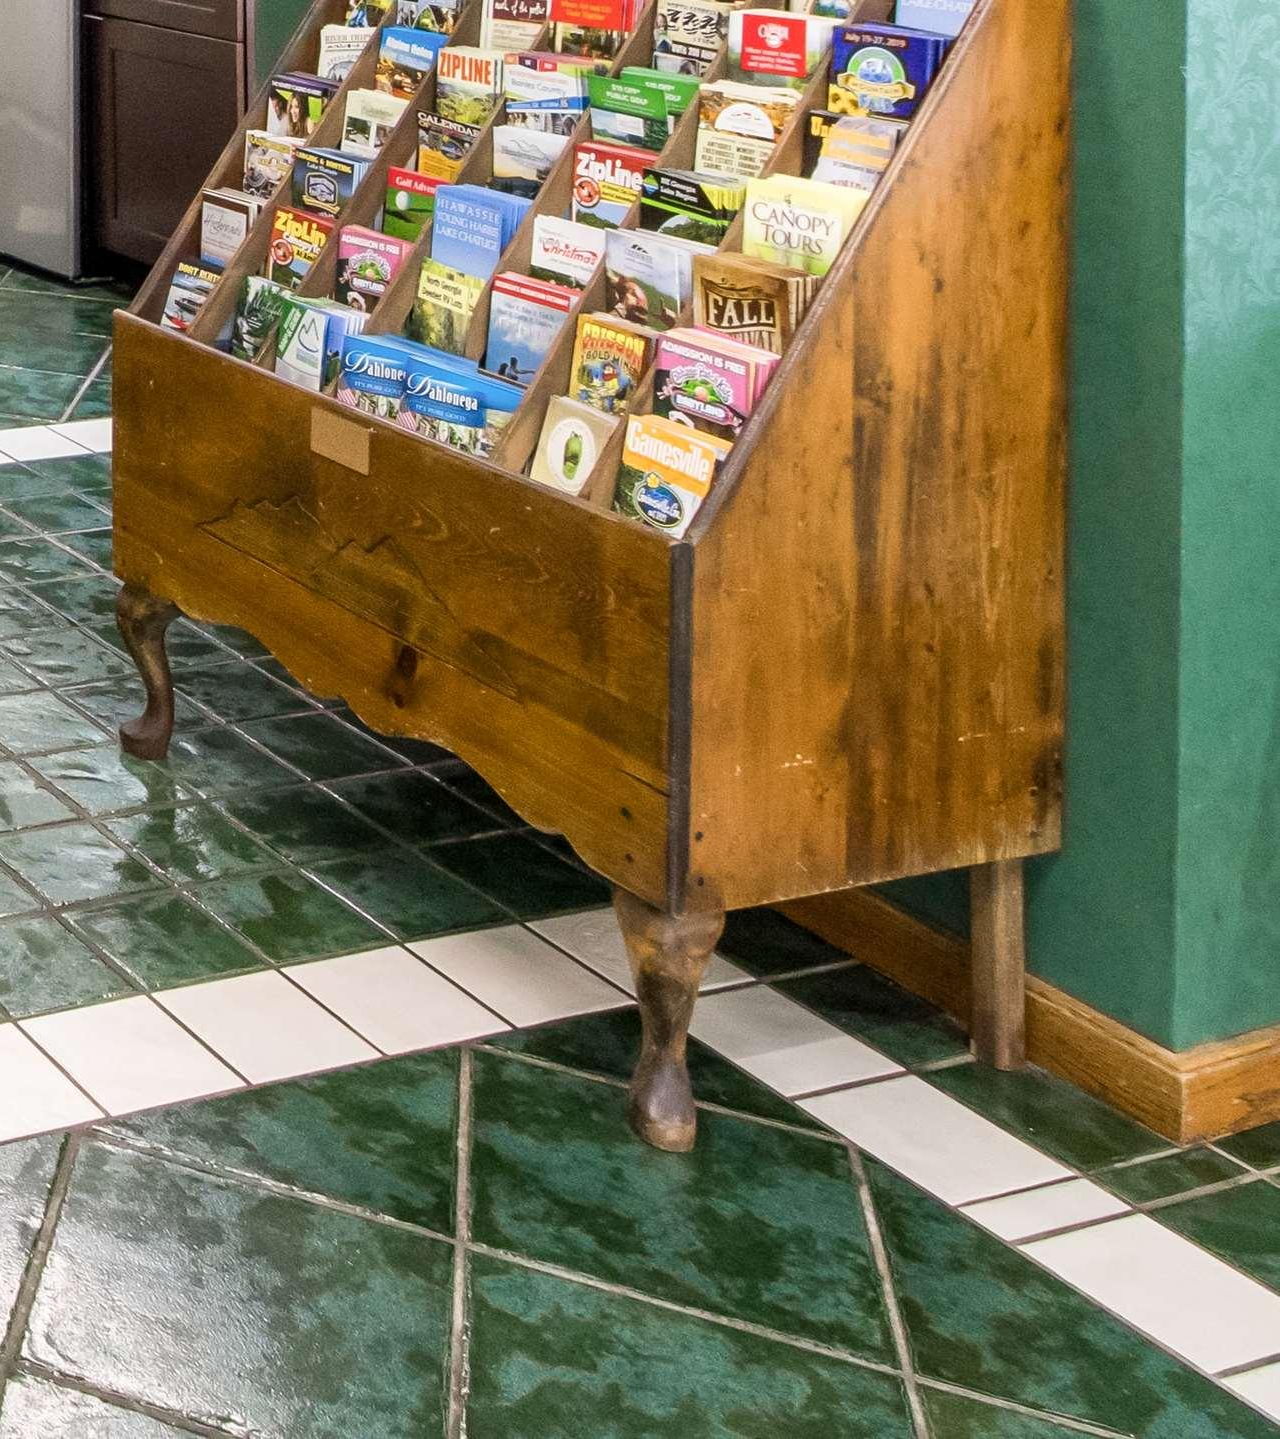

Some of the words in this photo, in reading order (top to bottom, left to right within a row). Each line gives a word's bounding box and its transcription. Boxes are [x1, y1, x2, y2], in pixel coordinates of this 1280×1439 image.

[510, 0, 518, 16] of
[518, 0, 528, 13] the
[845, 32, 861, 42] July
[439, 52, 491, 86] ZIPLINE
[396, 176, 411, 189] Golf
[412, 180, 435, 194] Adven
[576, 152, 642, 191] ZipLine
[274, 210, 327, 247] ZipLin
[436, 212, 469, 232] YOUNG
[752, 201, 834, 237] CANOPY
[341, 234, 378, 249] ADMISSION
[386, 245, 400, 255] FREE
[436, 224, 459, 239] LAKE
[458, 231, 498, 250] CHATUGE
[542, 234, 598, 264] Christmas
[760, 222, 823, 255] TOURS
[178, 262, 198, 276] BOAT
[199, 267, 222, 282] RENT
[441, 282, 463, 296] Georgia
[708, 291, 774, 327] FALL
[585, 350, 610, 361] GOLD
[661, 340, 712, 364] ADMISSION
[713, 357, 723, 367] IS
[724, 360, 746, 376] FREE
[407, 371, 478, 410] Dahlonega
[628, 420, 711, 481] Gainesville
